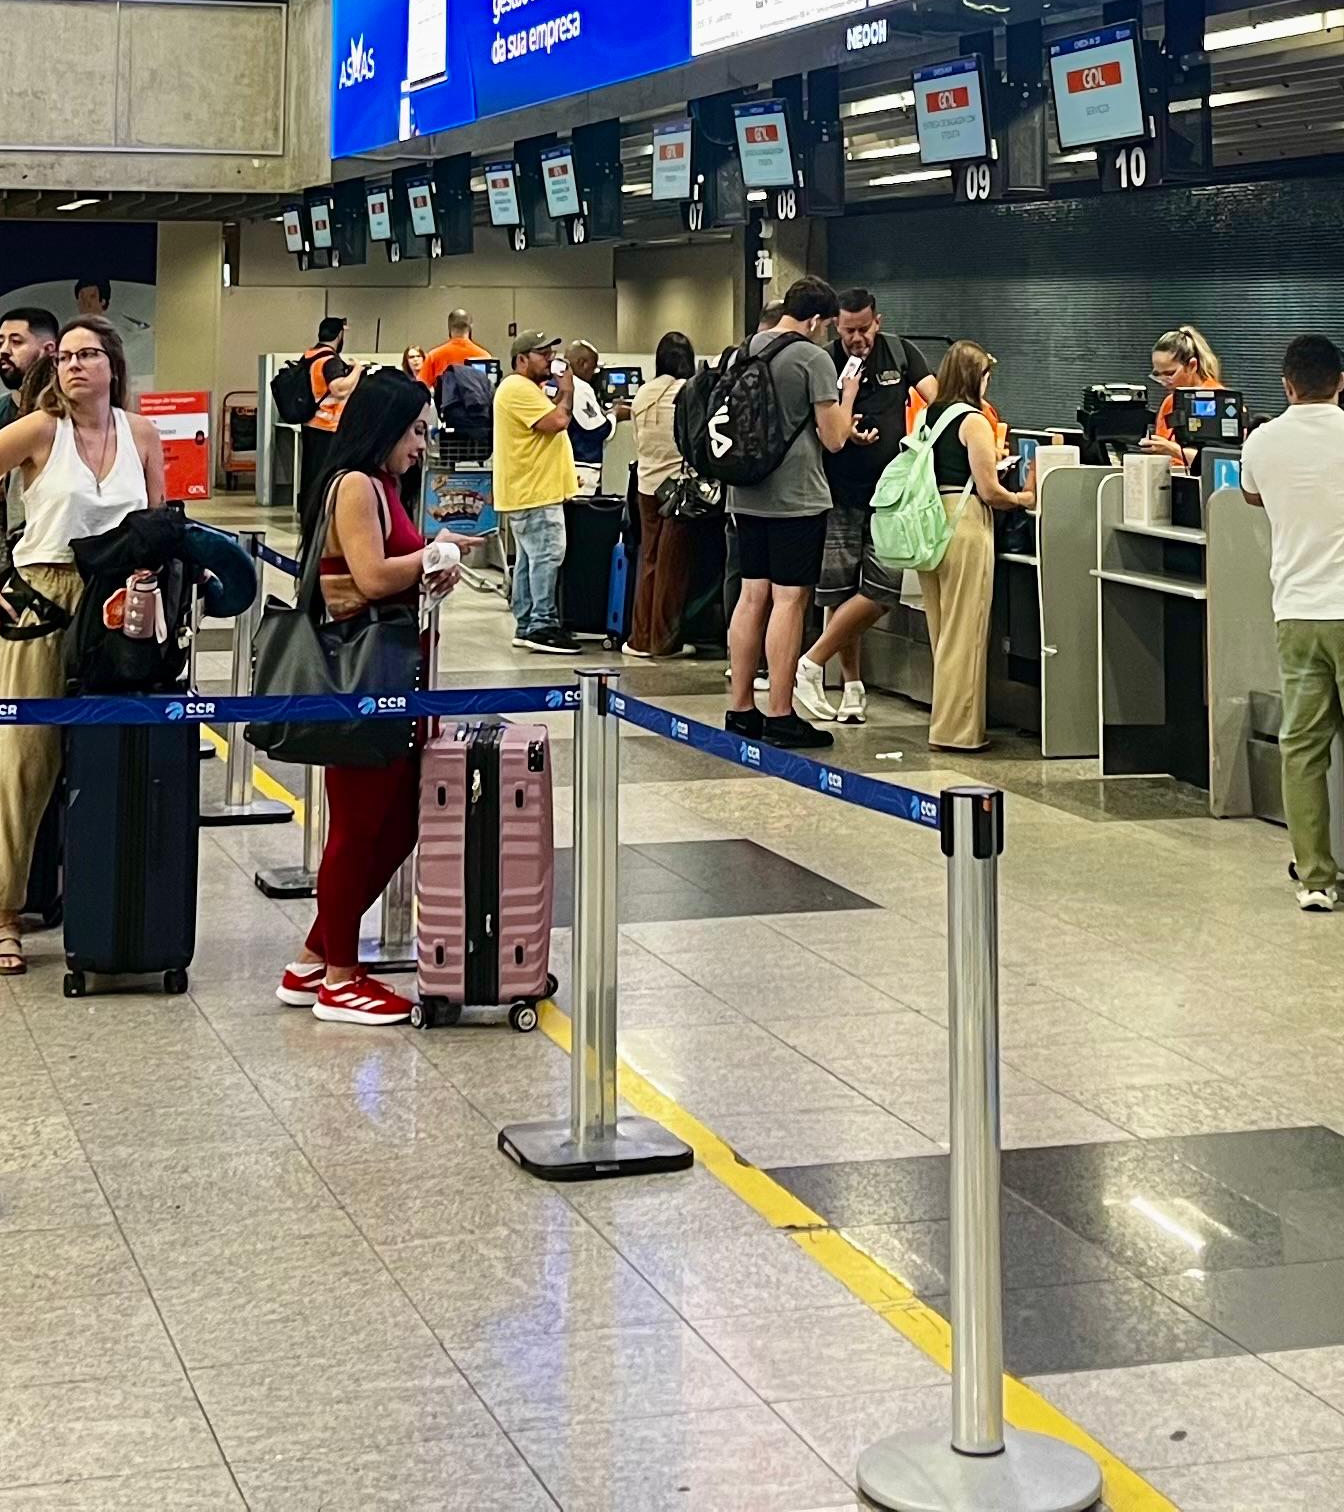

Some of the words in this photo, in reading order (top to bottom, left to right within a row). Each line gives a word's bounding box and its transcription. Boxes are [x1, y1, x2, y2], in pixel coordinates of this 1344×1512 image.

[491, 33, 506, 66] da
[506, 31, 527, 60] sua
[528, 10, 581, 55] empresa
[846, 18, 888, 51] NEOOH
[1082, 65, 1106, 89] GOL
[937, 90, 957, 110] GOL
[1115, 146, 1146, 189] 10
[965, 163, 991, 201] 09
[688, 202, 704, 231] 07
[776, 190, 797, 220] 08
[185, 702, 215, 714] CCR
[377, 696, 407, 709] CCR
[564, 690, 580, 702] CC
[920, 800, 937, 818] CCR
